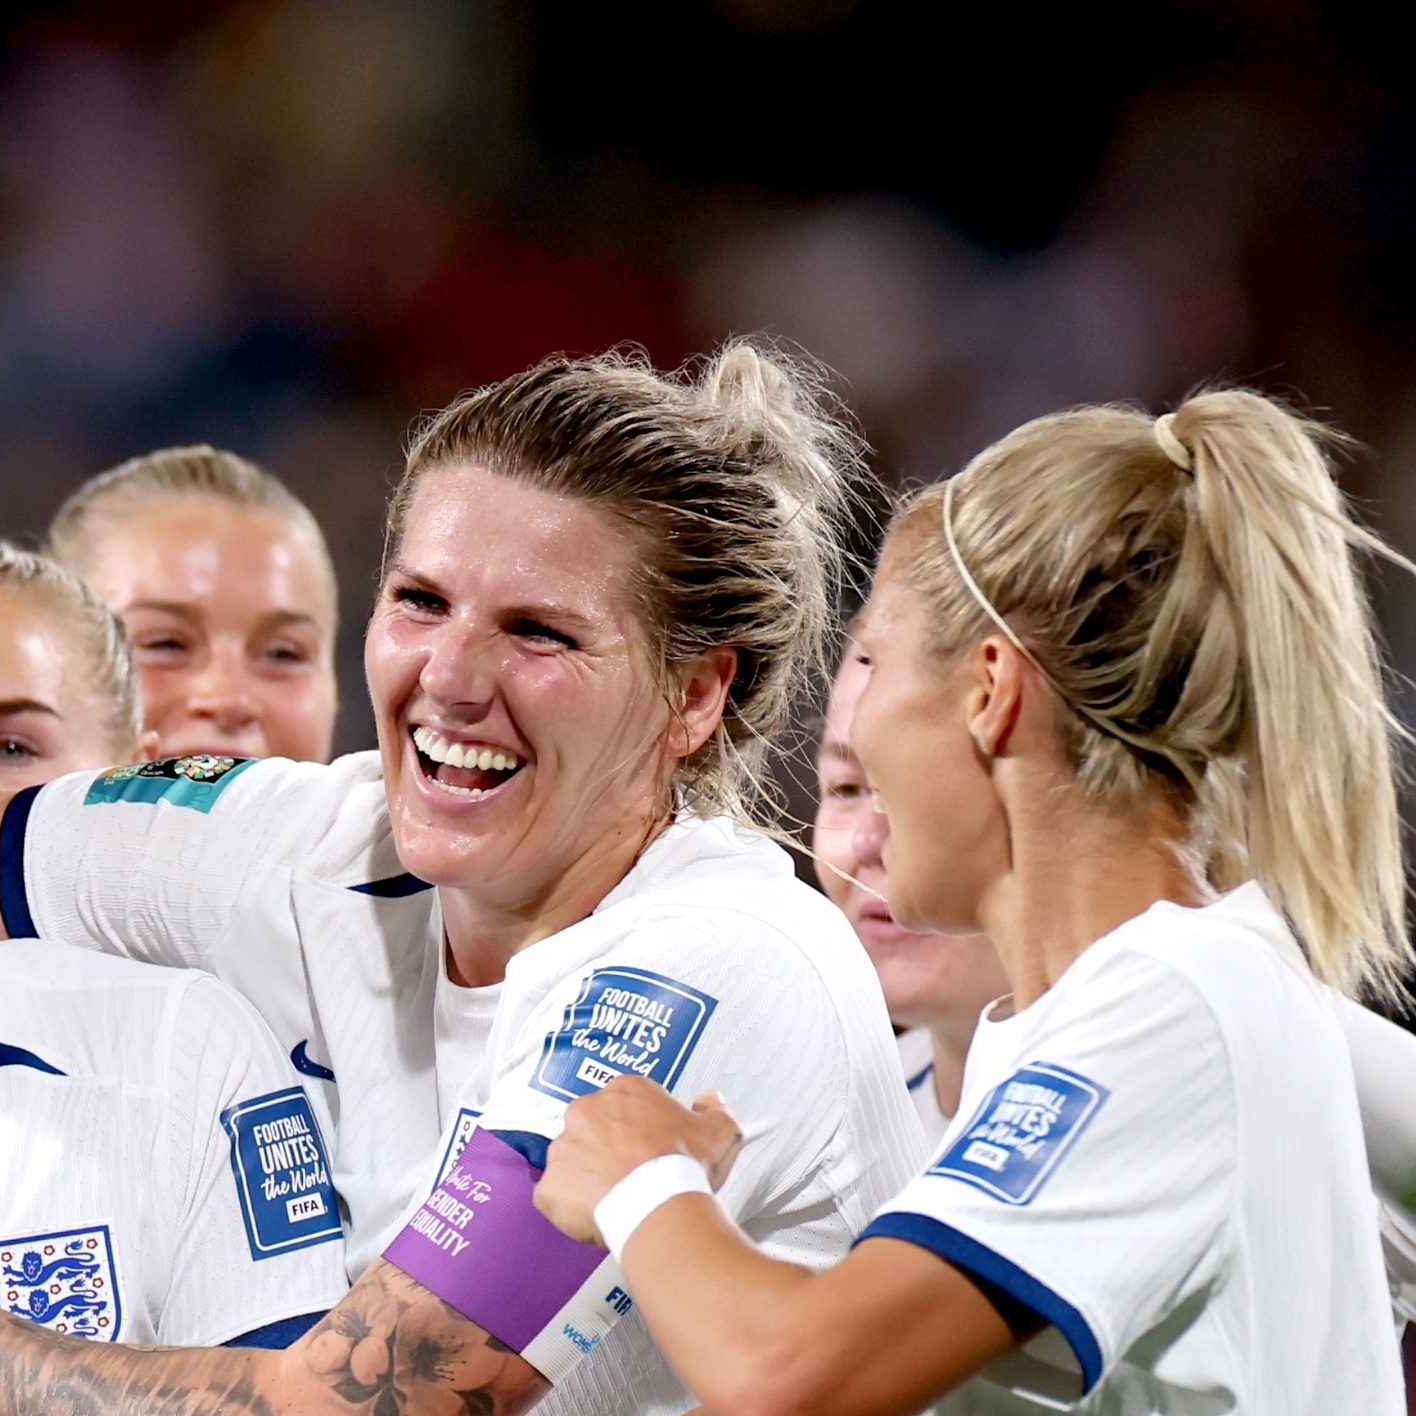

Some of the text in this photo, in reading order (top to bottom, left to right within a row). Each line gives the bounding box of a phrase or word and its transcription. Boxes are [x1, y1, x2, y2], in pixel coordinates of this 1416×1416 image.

[597, 986, 674, 1028] FOOTBALL
[589, 1003, 667, 1053] UNITES
[571, 1028, 660, 1078] the World
[1002, 1081, 1067, 1115] FOOTBALL
[252, 1114, 310, 1146] FOOTBALL
[988, 1101, 1058, 1138] UNITES
[258, 1134, 320, 1174] UNITES
[260, 1161, 330, 1201] the World
[465, 1181, 492, 1204] For
[292, 1200, 319, 1216] FIFA
[426, 1188, 475, 1230] GENDER
[409, 1208, 471, 1257] EQUALITY
[605, 1286, 633, 1316] FIF
